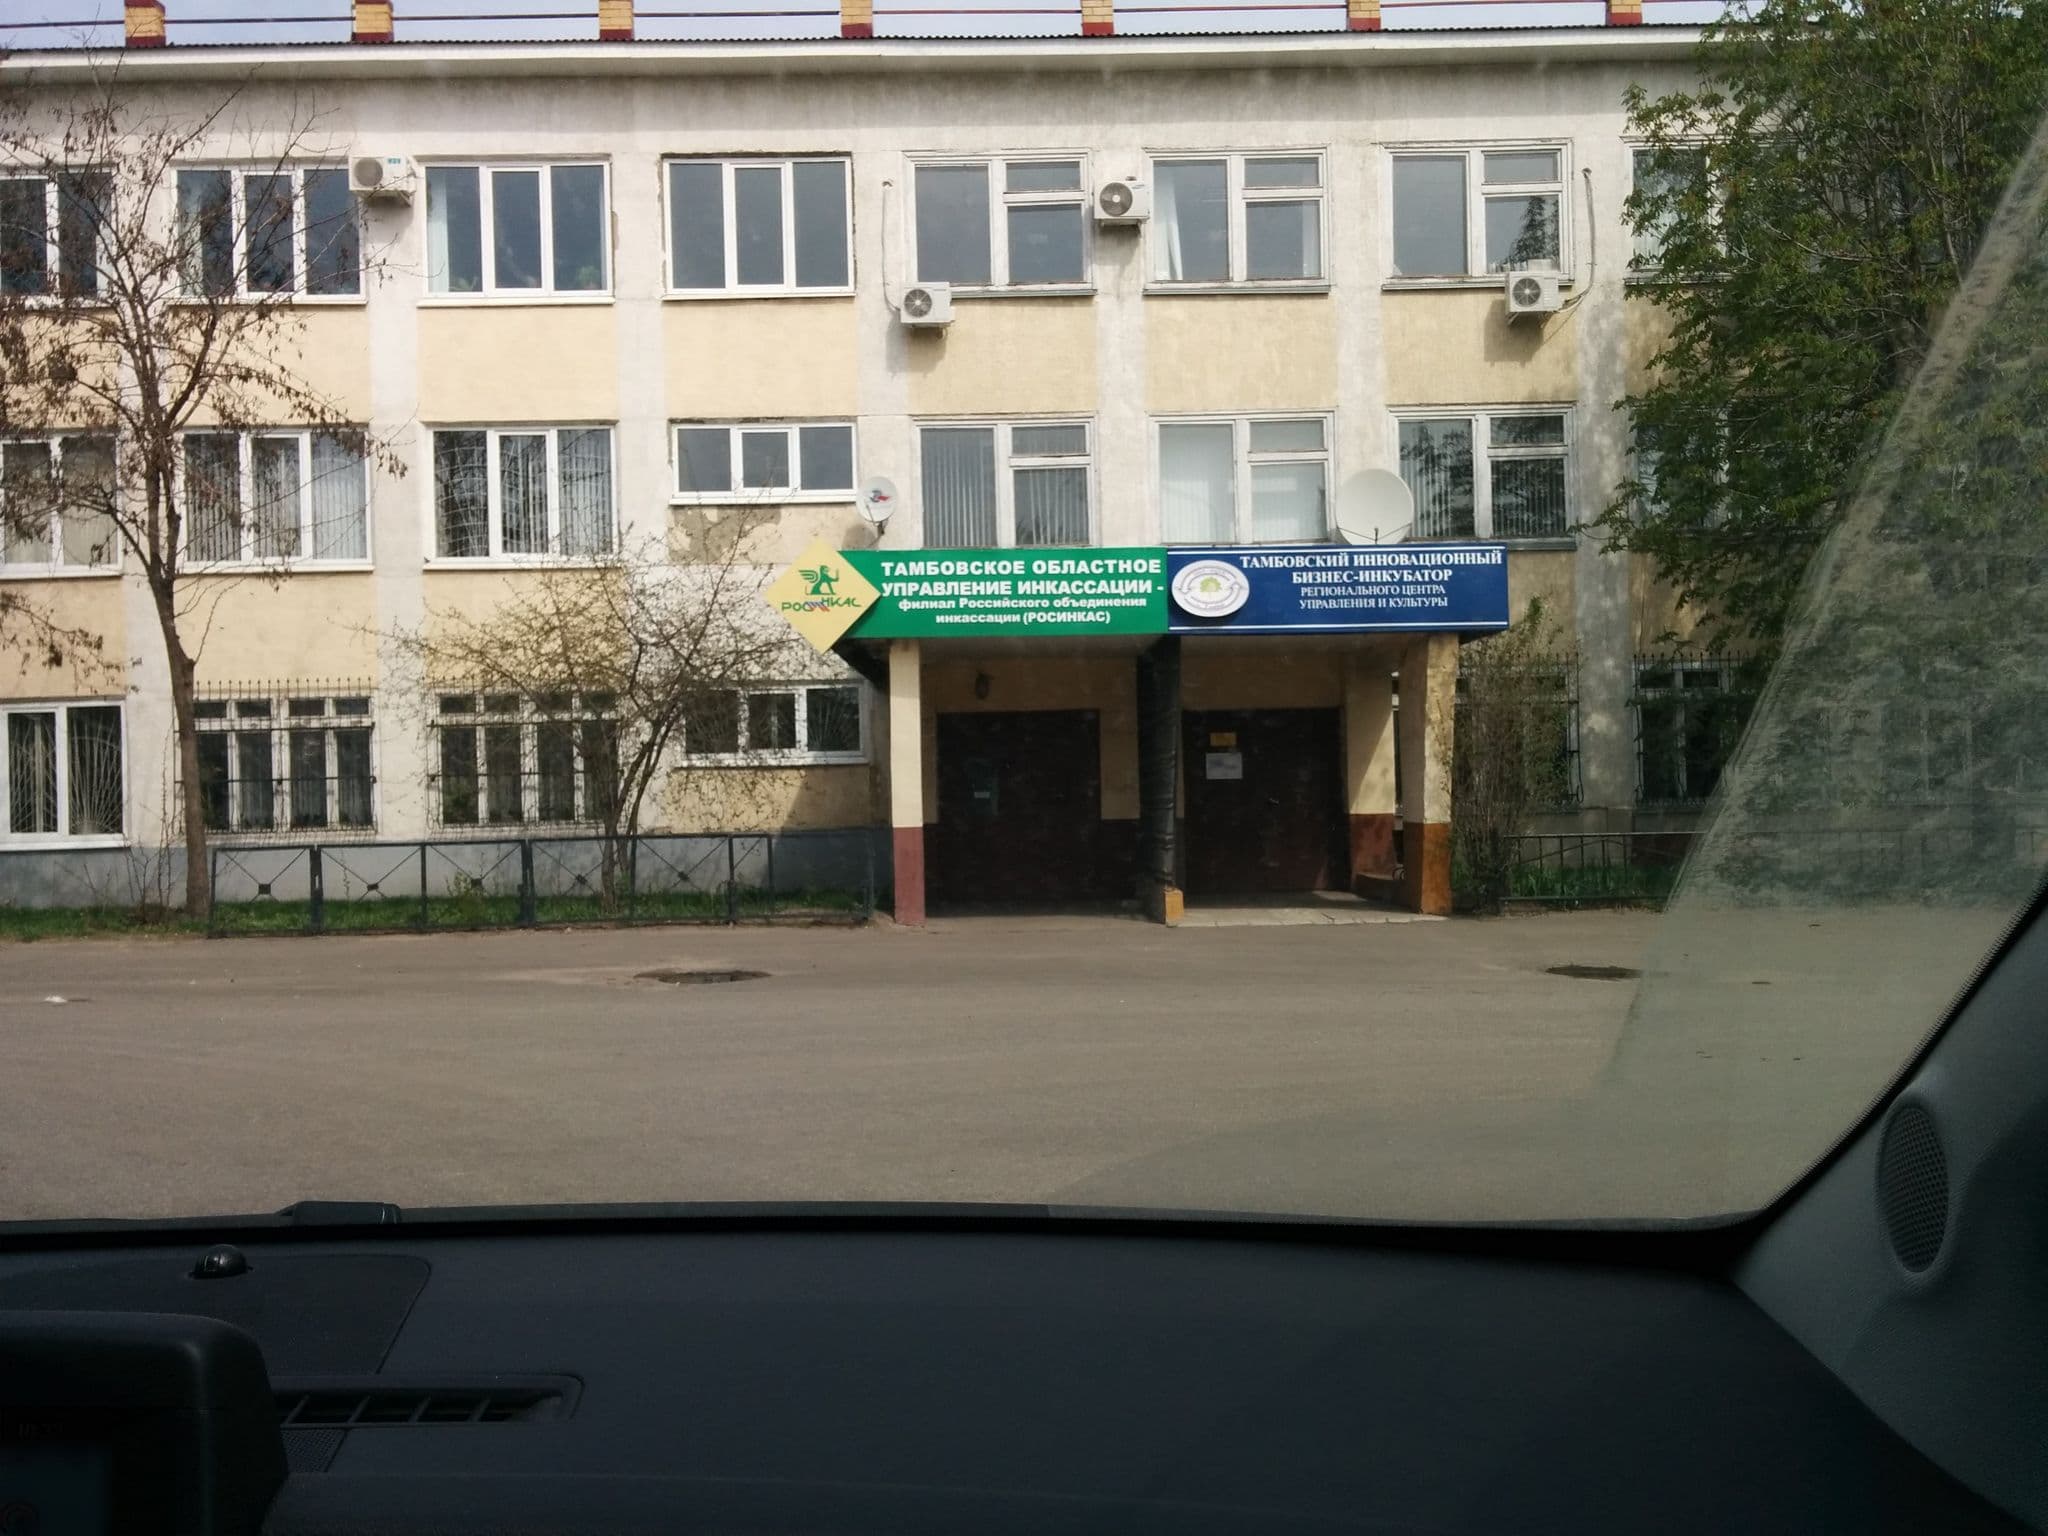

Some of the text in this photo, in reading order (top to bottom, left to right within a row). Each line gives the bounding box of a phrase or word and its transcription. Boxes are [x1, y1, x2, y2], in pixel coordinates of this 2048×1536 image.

[880, 558, 1161, 577] ТАМБОВСКОЕ ОБЛАСТНОЕ
[1239, 550, 1502, 569] ТАМБОВСКИЙ ИННОВАЦИОННЫЙ
[1292, 569, 1453, 585] БИЗНЕС-ИНКУБАТОР
[881, 580, 1012, 597] УПРАВЛЕНИЕ
[1017, 579, 1153, 598] ИНКАССАЦИИ
[1300, 585, 1446, 597] РЕГИОНАЛЬНОГО ЦЕНТРА
[898, 596, 1147, 612] филиал Российского объединения
[1299, 596, 1448, 609] УПРАВЛЕНИЯ И КУЛЬТУРЫ
[935, 610, 1111, 625] инкассации (РОСИНКАС)
